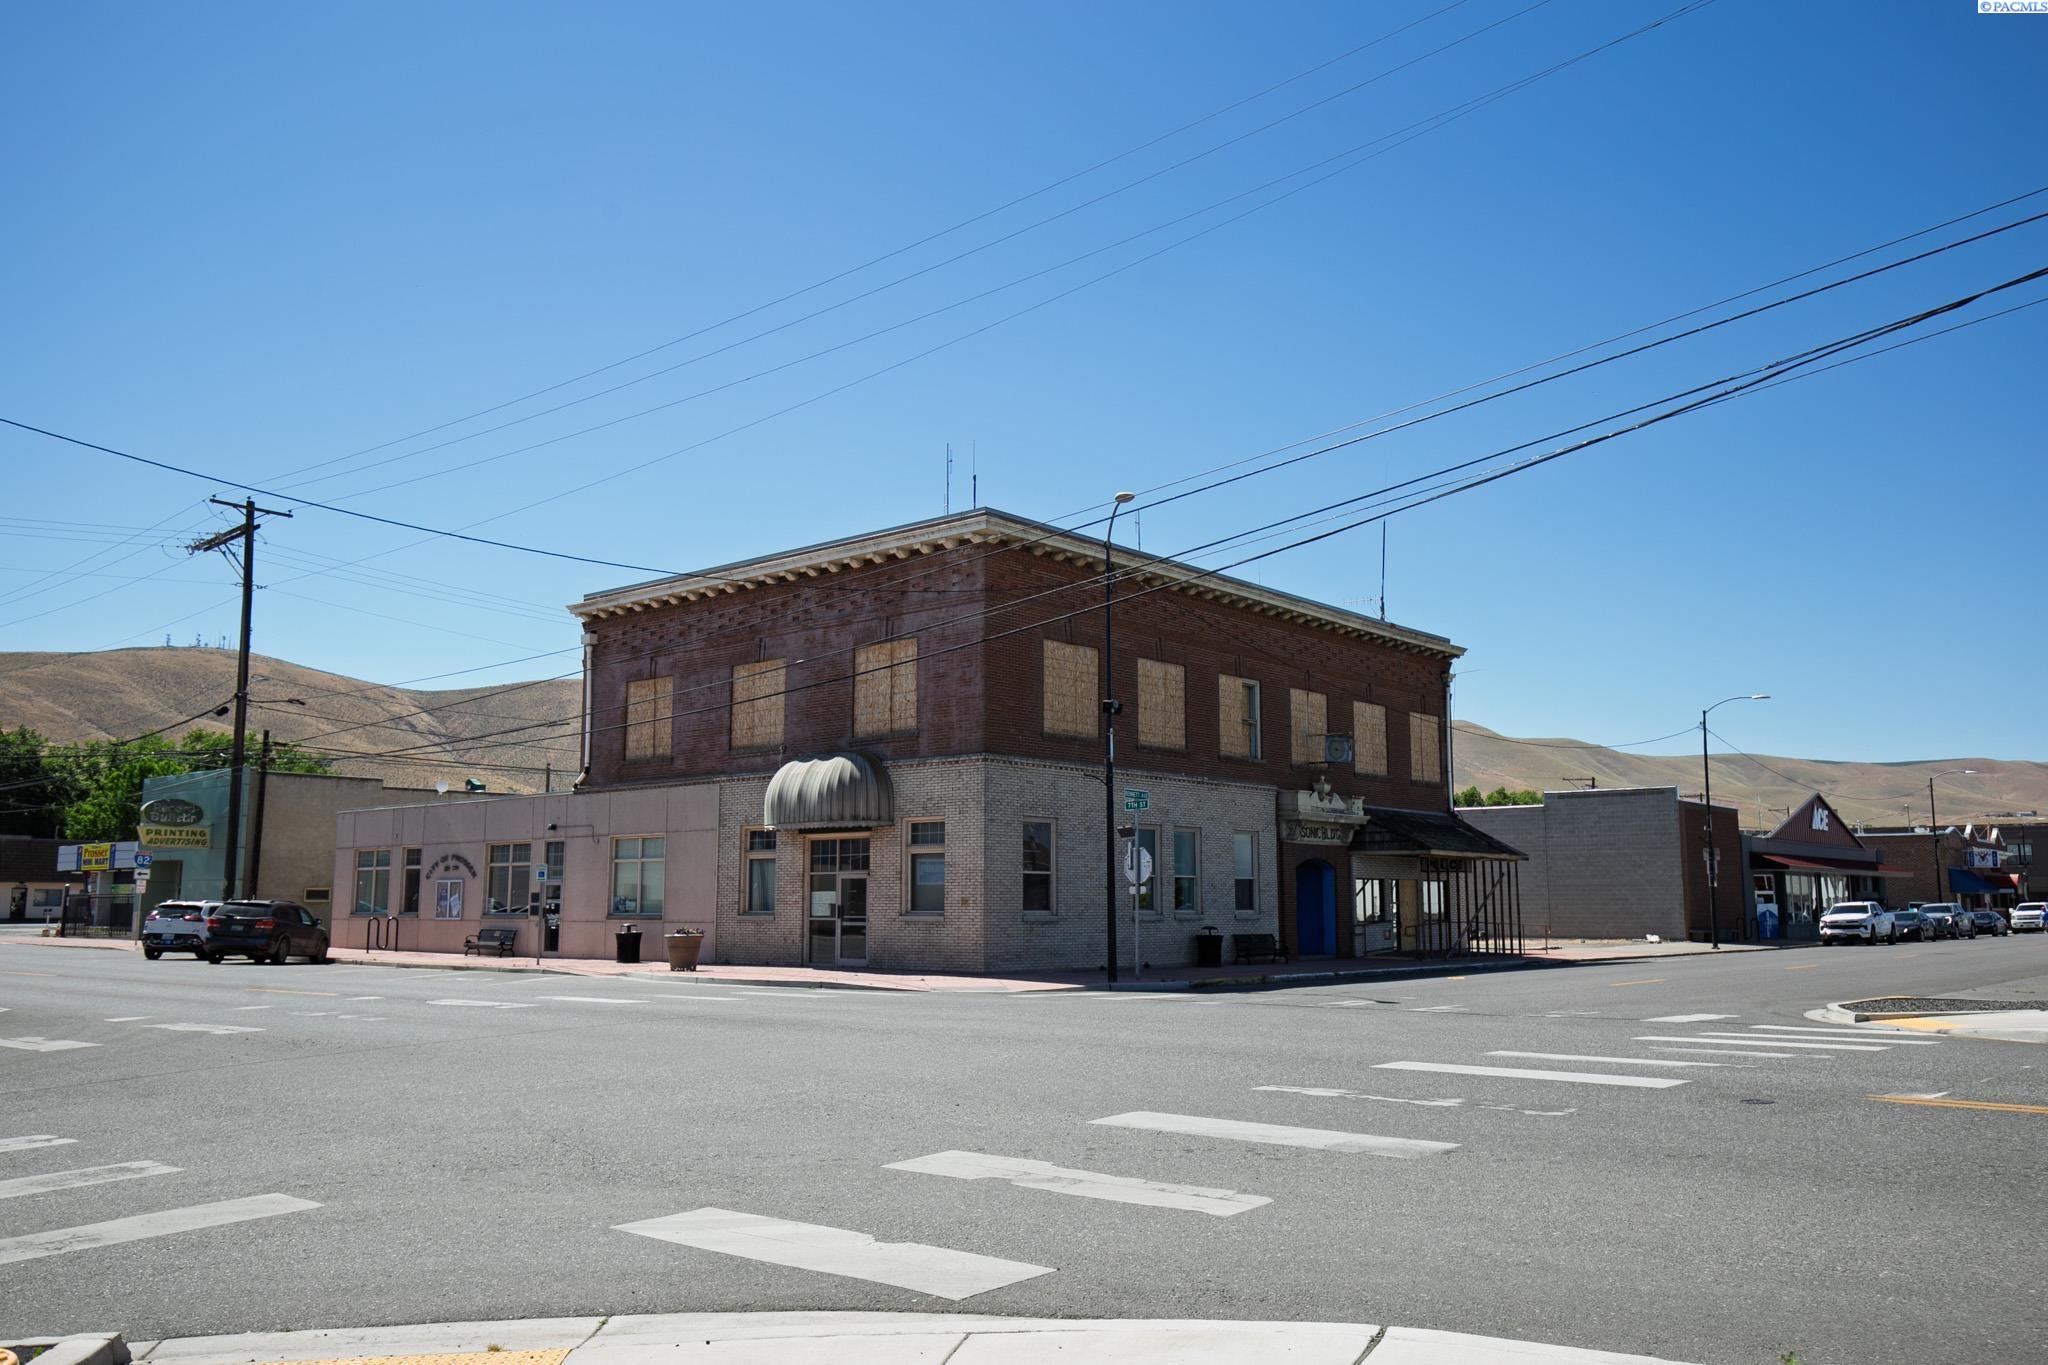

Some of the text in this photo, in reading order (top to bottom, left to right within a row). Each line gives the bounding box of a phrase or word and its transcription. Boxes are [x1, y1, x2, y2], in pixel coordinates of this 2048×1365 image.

[1812, 805, 1829, 831] ACE
[146, 828, 206, 837] PRINTING
[147, 837, 208, 846] ADVERTISING
[84, 848, 108, 858] Prosser
[137, 856, 150, 864] 82
